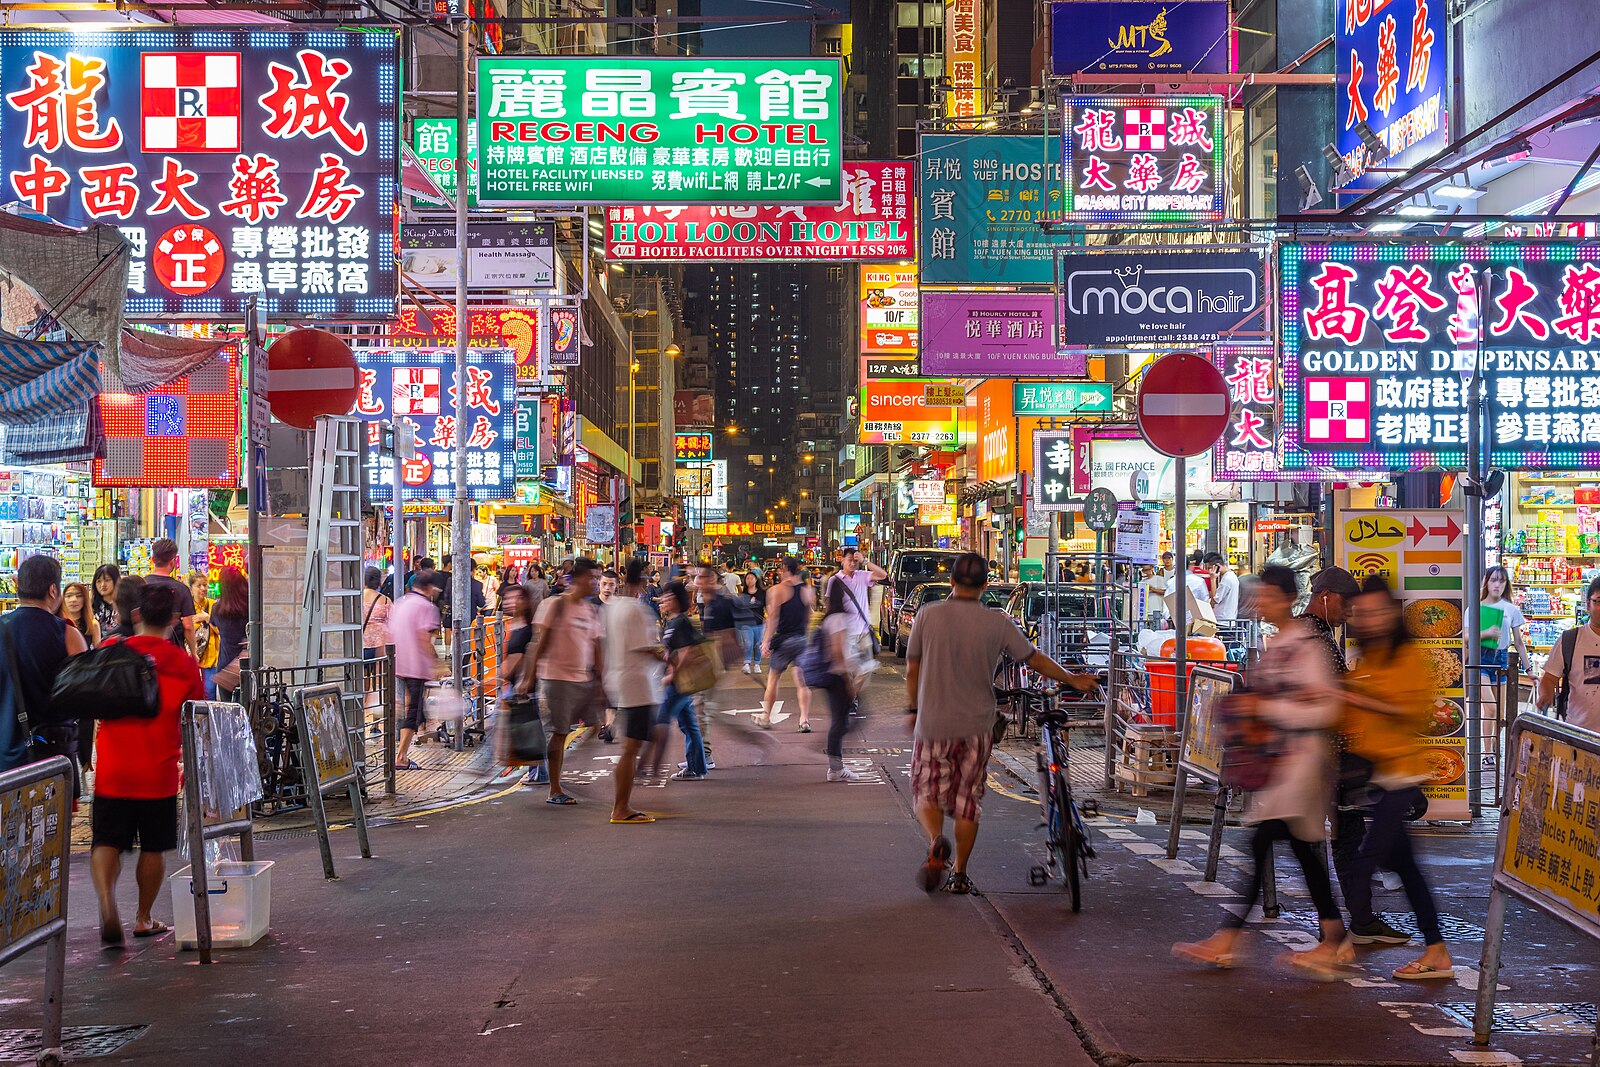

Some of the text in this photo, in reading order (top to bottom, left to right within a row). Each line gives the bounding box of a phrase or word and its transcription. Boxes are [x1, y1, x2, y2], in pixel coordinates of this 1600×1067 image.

[7, 51, 123, 153] 龍
[258, 49, 368, 155] 城
[487, 68, 833, 122] 麗晶賓館
[491, 121, 829, 146] REGENG HOTEL
[1075, 108, 1123, 151] 龍
[1168, 108, 1214, 153] 城
[486, 146, 831, 167] 持牌賓館 酒店設備 豪華套房 歡迎自由行
[973, 159, 998, 169] SING
[487, 169, 530, 181] HOTEL
[532, 169, 588, 181] FACILITY
[591, 169, 644, 181] LIENSED
[973, 171, 998, 181] YUET
[1080, 153, 1209, 194] 大藥房
[10, 152, 366, 225] 中西大藥房
[487, 181, 530, 192] HOTEL
[532, 181, 562, 192] FREE
[564, 181, 593, 192] WIFI
[881, 167, 892, 218] 全日特平
[1075, 195, 1214, 211] DRAGON CITY DISPENSARY
[1000, 210, 1031, 221] 2770
[443, 227, 481, 240] Maage
[610, 220, 907, 243] HOI LOON HOTEL
[231, 226, 370, 259] 專營批發
[640, 246, 687, 256] HOTEL
[689, 245, 763, 256] FACILITEIS
[765, 245, 802, 256] OVER
[804, 245, 850, 256] NIGHT
[852, 245, 884, 256] LESS
[887, 245, 907, 255] 20%
[478, 251, 501, 259] Health
[170, 253, 207, 288] 正
[230, 261, 369, 294] 蟲草燕窩
[536, 271, 549, 279] 1/F
[866, 273, 914, 282] KING WAH
[1083, 286, 1245, 315] moca hair
[884, 311, 905, 323] 10/F
[1139, 322, 1186, 330] We love hair
[1105, 333, 1156, 342] appointment
[1158, 333, 1175, 341] call:
[1176, 333, 1199, 341] 2388
[1041, 353, 1074, 361] BUILDING
[1303, 350, 1600, 372] GOLDEN DIPENSARY
[869, 364, 888, 373] 12/F
[1230, 408, 1272, 448] 大
[911, 432, 954, 441] 2377-2263
[1094, 462, 1155, 471] 法國 FRANCE
[1136, 479, 1149, 494] 5M
[1349, 519, 1404, 542] حلال
